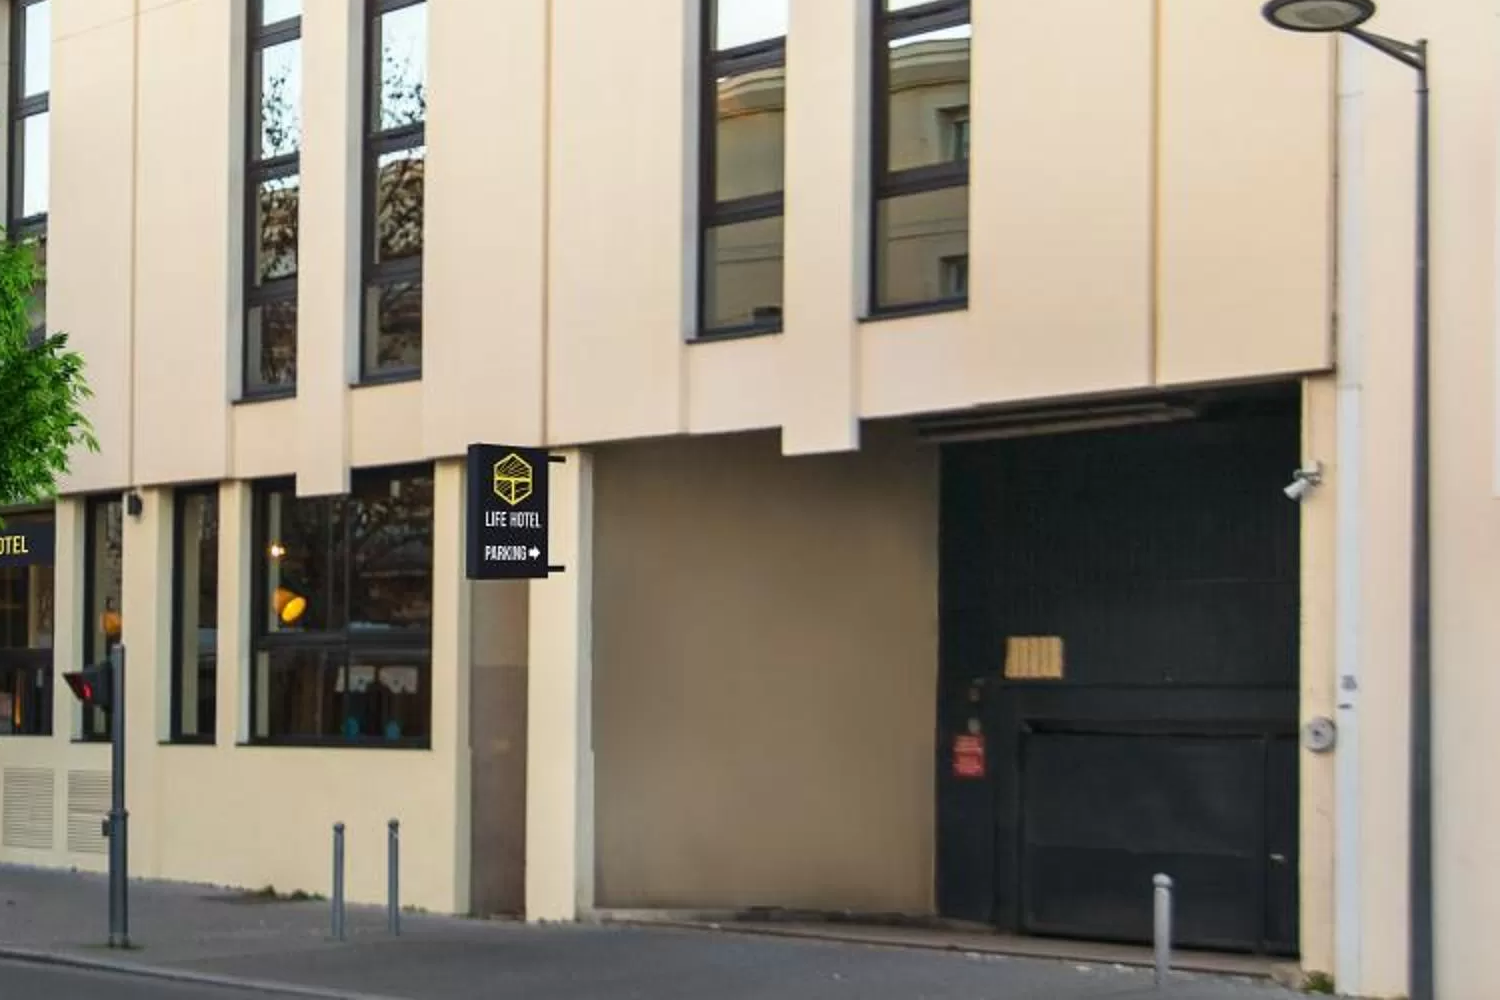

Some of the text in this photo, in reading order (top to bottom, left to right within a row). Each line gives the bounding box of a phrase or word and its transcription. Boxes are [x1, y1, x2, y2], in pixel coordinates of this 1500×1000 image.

[485, 511, 541, 528] LIFE HOTEL
[484, 546, 527, 561] PARKING
